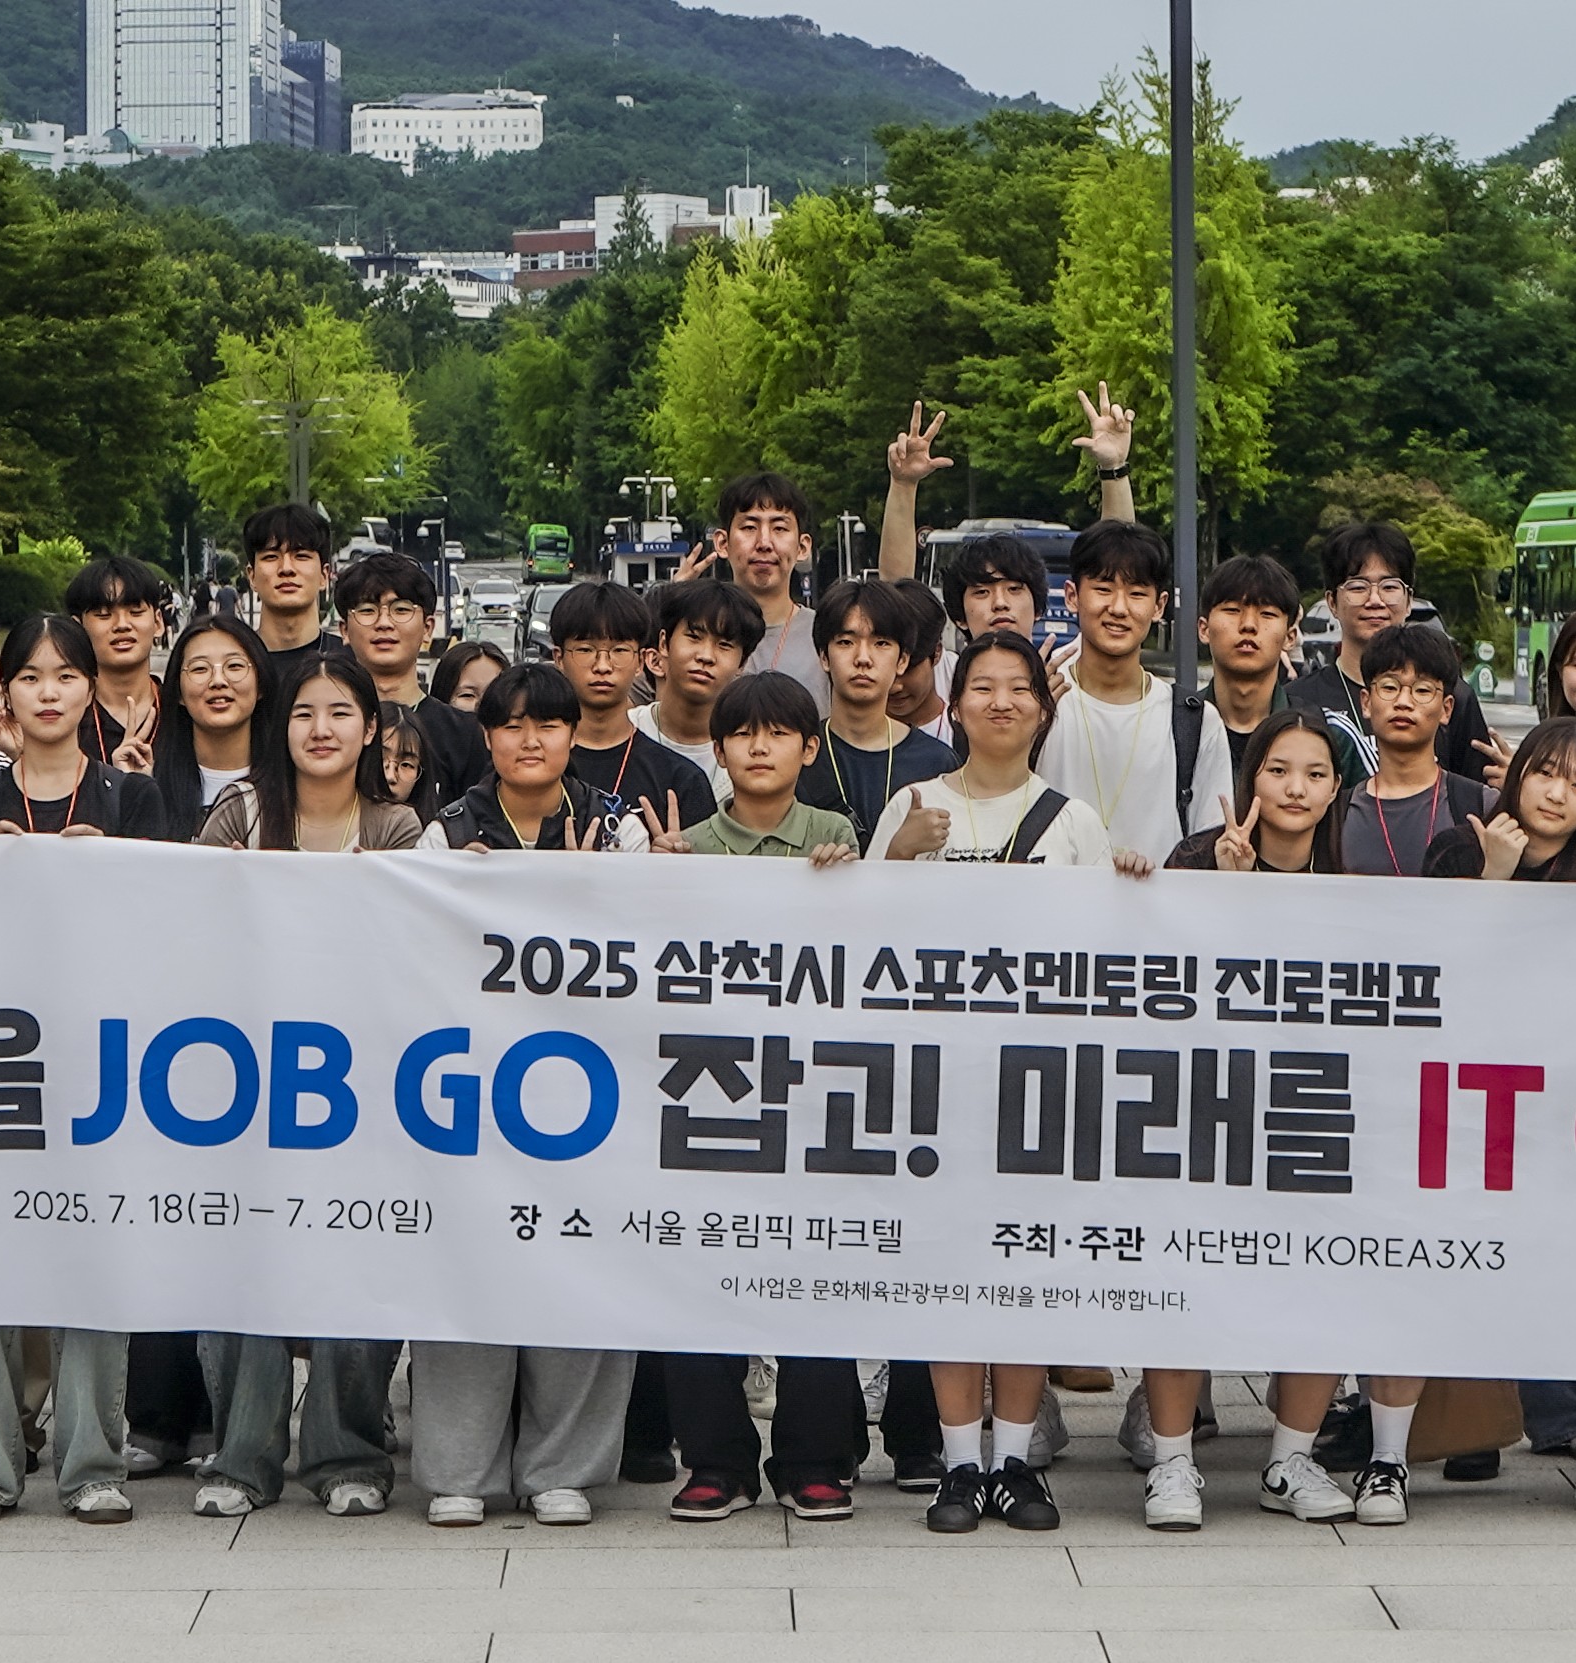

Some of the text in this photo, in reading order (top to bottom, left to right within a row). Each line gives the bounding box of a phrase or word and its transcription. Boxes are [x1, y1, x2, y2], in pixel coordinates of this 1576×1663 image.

[481, 934, 1442, 1028] 2025 삼척시 스포츠멘토링 진로캠프
[72, 1017, 358, 1150] JOB
[394, 1027, 619, 1161] GO
[658, 1034, 940, 1178] 잡고!
[997, 1044, 1356, 1193] 미래를
[1418, 1062, 1545, 1191] IT
[14, 1190, 96, 1224] 2025.
[109, 1195, 134, 1224] 7.
[287, 1198, 312, 1229] 7.
[327, 1199, 433, 1233] 20(일)
[621, 1210, 686, 1246] 서울
[697, 1213, 793, 1250] 올림픽
[806, 1217, 902, 1253] 파크텔
[1164, 1229, 1291, 1265] 사단법인
[1306, 1236, 1505, 1270] KOREA3X3
[721, 1277, 1191, 1312] 이 사업은 문화체육관광부의 지원을 받아 시행합니다.
